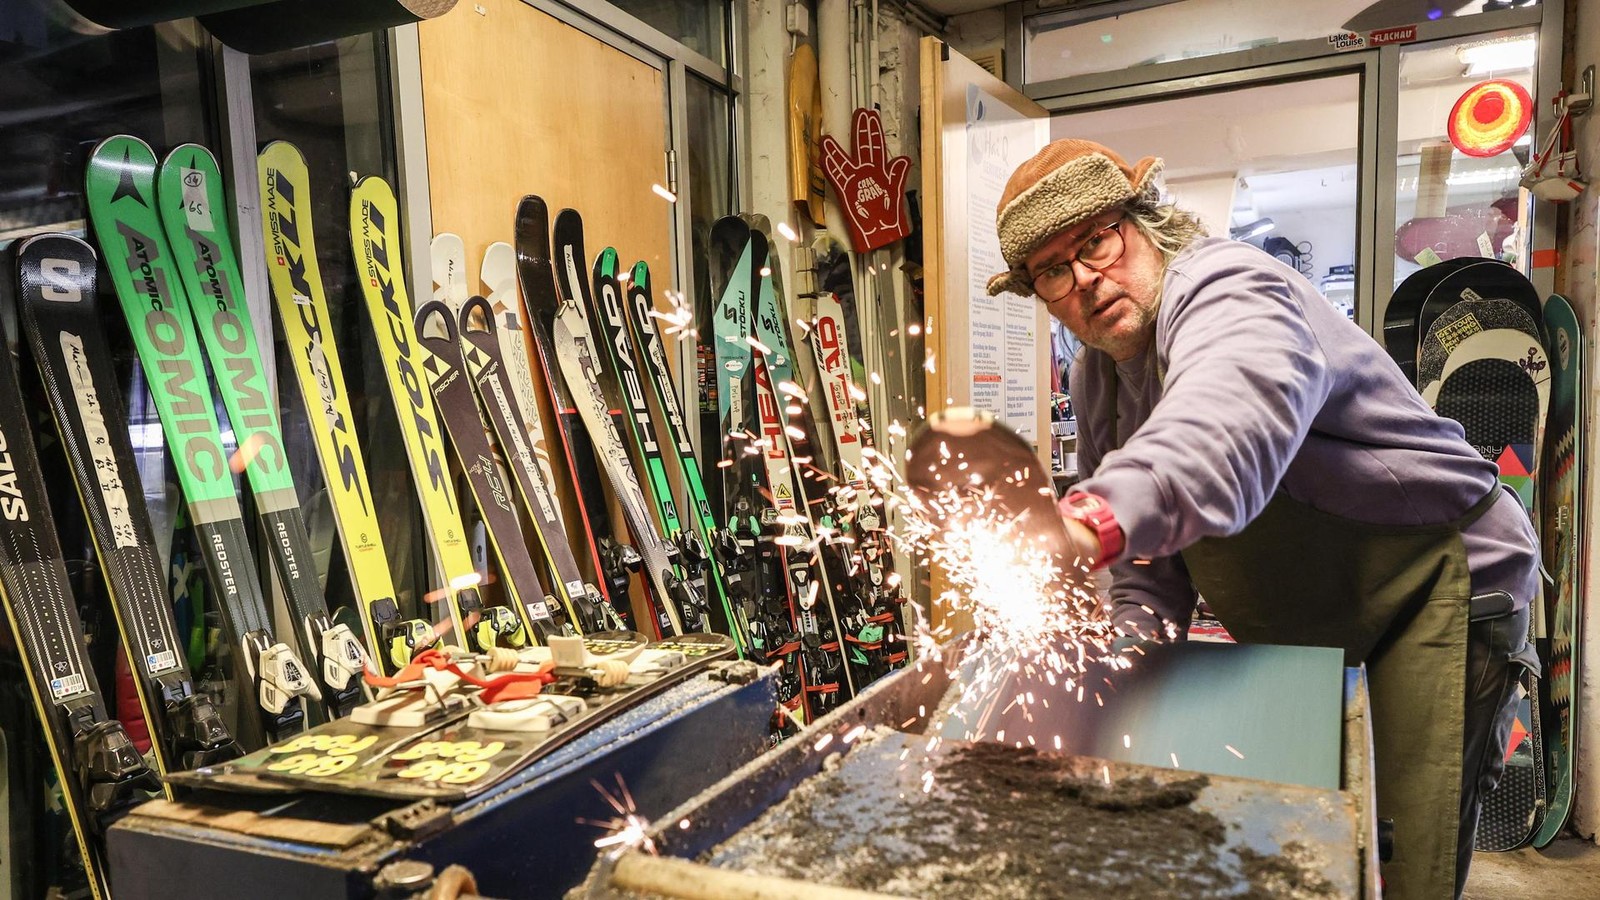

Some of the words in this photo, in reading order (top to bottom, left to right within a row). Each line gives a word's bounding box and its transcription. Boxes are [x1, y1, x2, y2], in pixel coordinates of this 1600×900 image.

[1329, 33, 1349, 43] Lake
[1336, 38, 1363, 48] Louise
[1374, 30, 1412, 42] FLACHAU
[266, 167, 277, 211] MADE
[857, 184, 883, 203] GRAB
[858, 176, 876, 190] CRAB
[270, 213, 284, 255] SWISS
[361, 199, 370, 236] MADE
[132, 237, 163, 312] ATOMIC
[198, 239, 227, 312] ATOMIC
[365, 239, 376, 279] SWISS
[738, 290, 747, 339] STÖCKLI
[768, 301, 785, 349] STÖCKLI
[115, 219, 224, 483] ATOMIC
[184, 224, 284, 474] ATOMIC
[602, 284, 657, 452] HEAD
[434, 370, 460, 396] FISCHER
[754, 350, 785, 459] HEA
[211, 534, 237, 595] REDSTER
[276, 522, 299, 580] REDSTER
